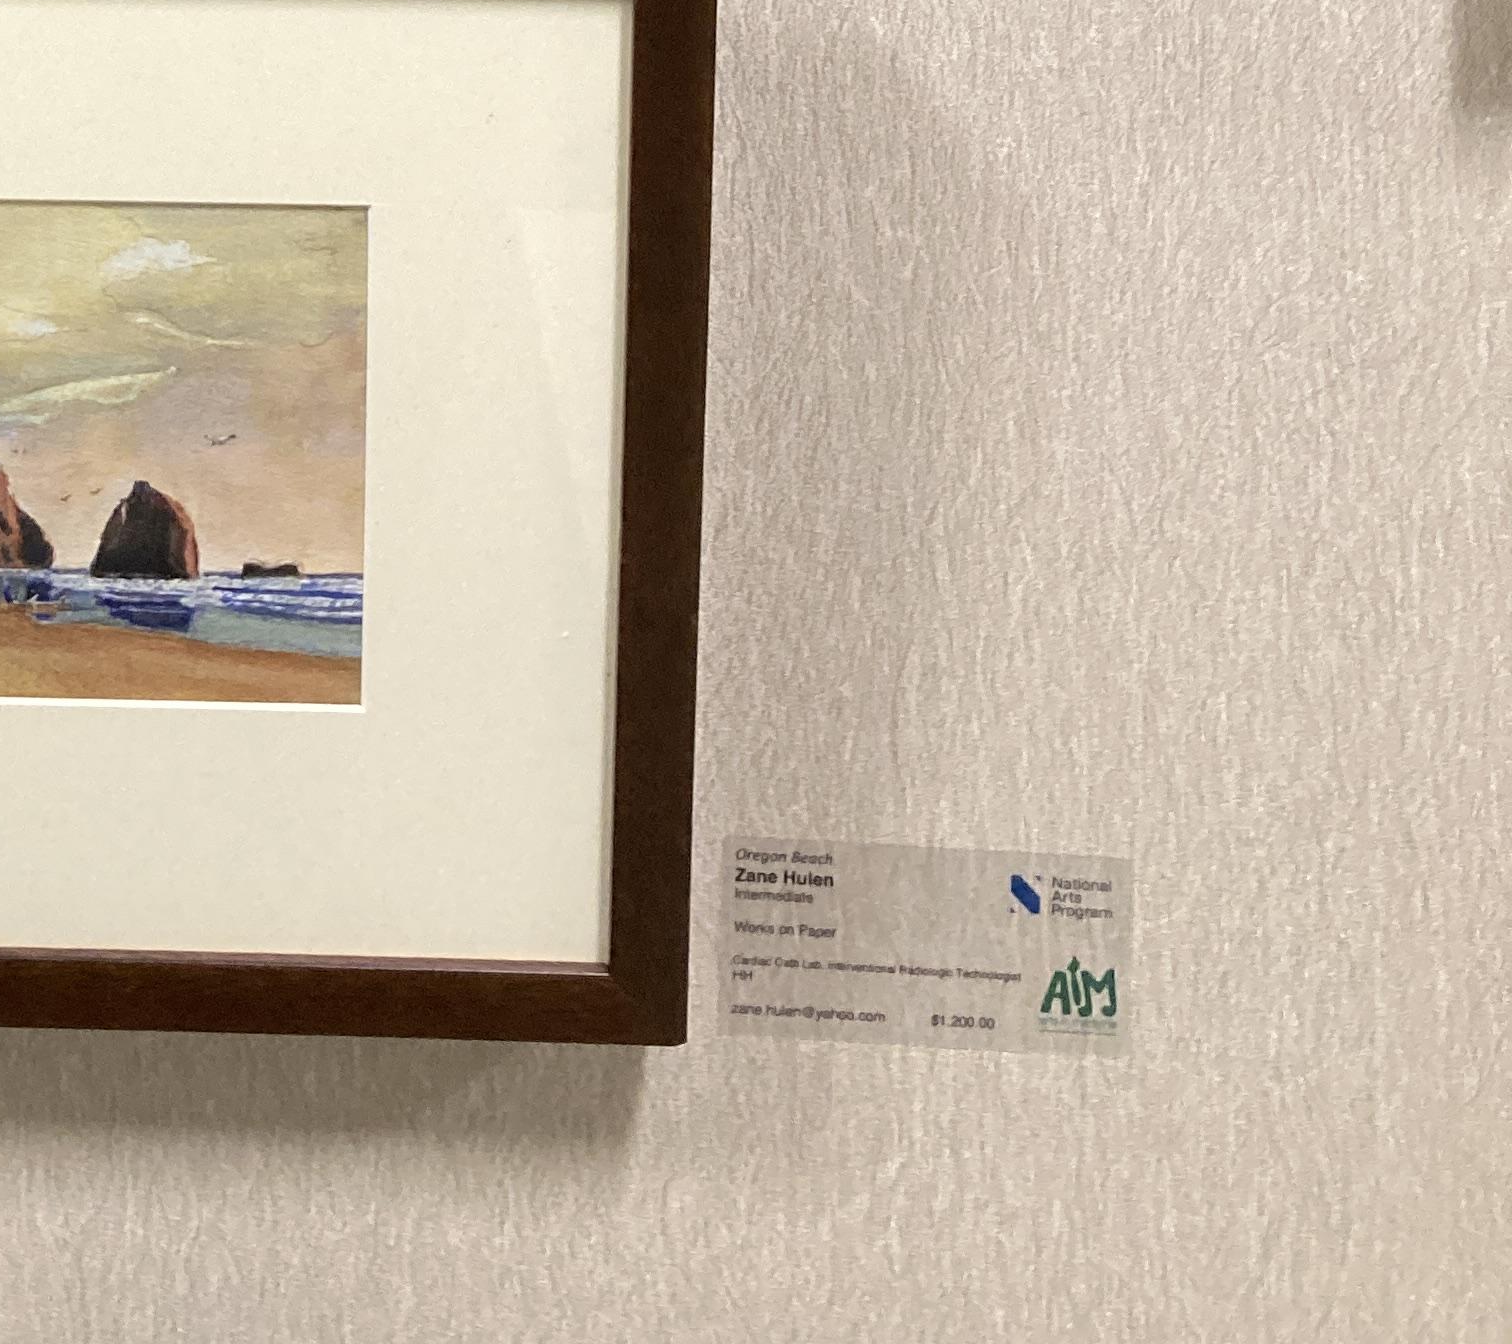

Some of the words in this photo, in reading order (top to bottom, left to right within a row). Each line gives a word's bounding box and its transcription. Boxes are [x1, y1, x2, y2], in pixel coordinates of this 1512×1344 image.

[735, 848, 788, 865] Oregon
[791, 851, 834, 866] Beach
[735, 867, 779, 884] Zane
[783, 869, 835, 888] Hulen
[1051, 876, 1113, 893] National
[1051, 890, 1083, 904] Arts
[1051, 903, 1114, 919] Program
[798, 923, 837, 938] Paper
